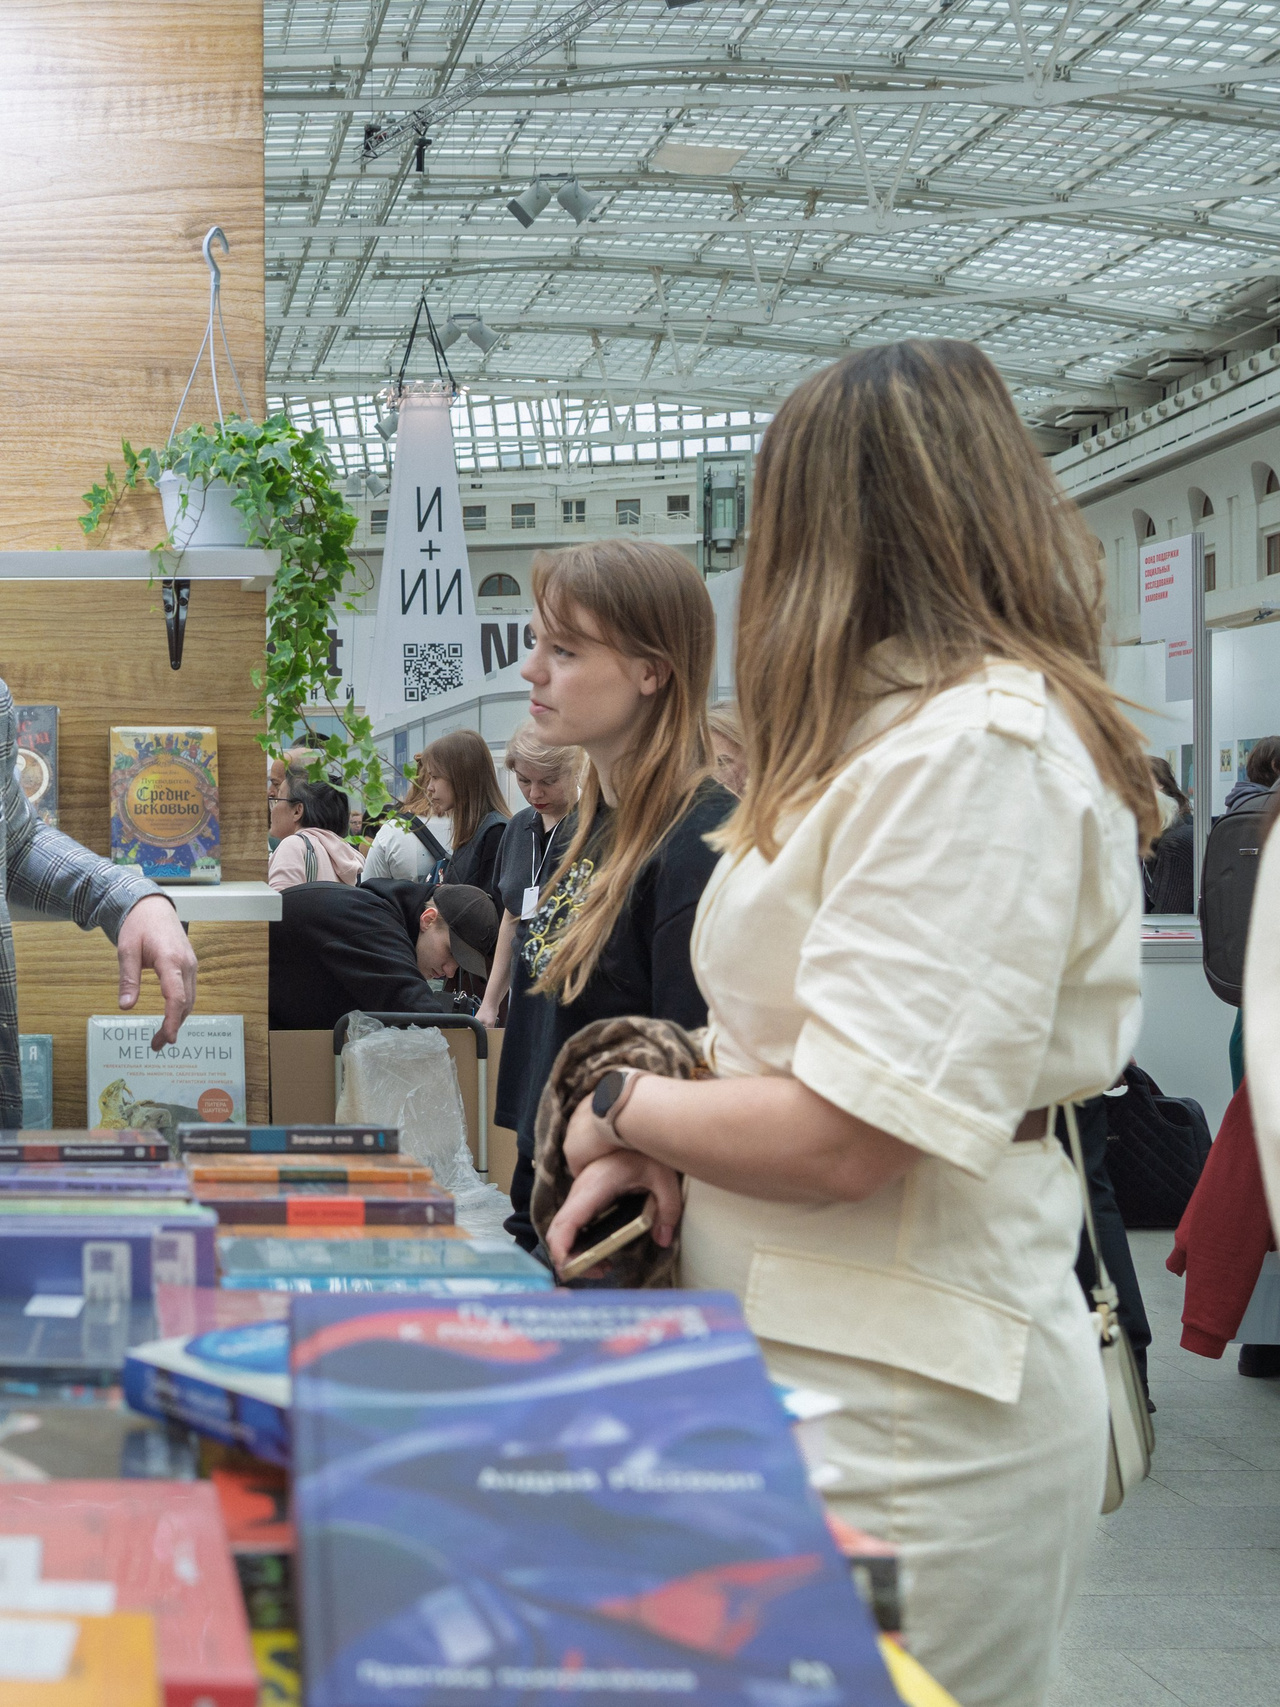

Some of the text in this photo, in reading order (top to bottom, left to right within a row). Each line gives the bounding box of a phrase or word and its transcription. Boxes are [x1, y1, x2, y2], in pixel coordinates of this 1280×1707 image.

[1144, 554, 1156, 565] ФОНД
[400, 568, 463, 616] ИИ
[136, 786, 196, 803] Средне-
[133, 803, 200, 815] вековью
[102, 1027, 156, 1041] КОНЕ
[118, 1046, 233, 1060] МЕГАФАУНЫ
